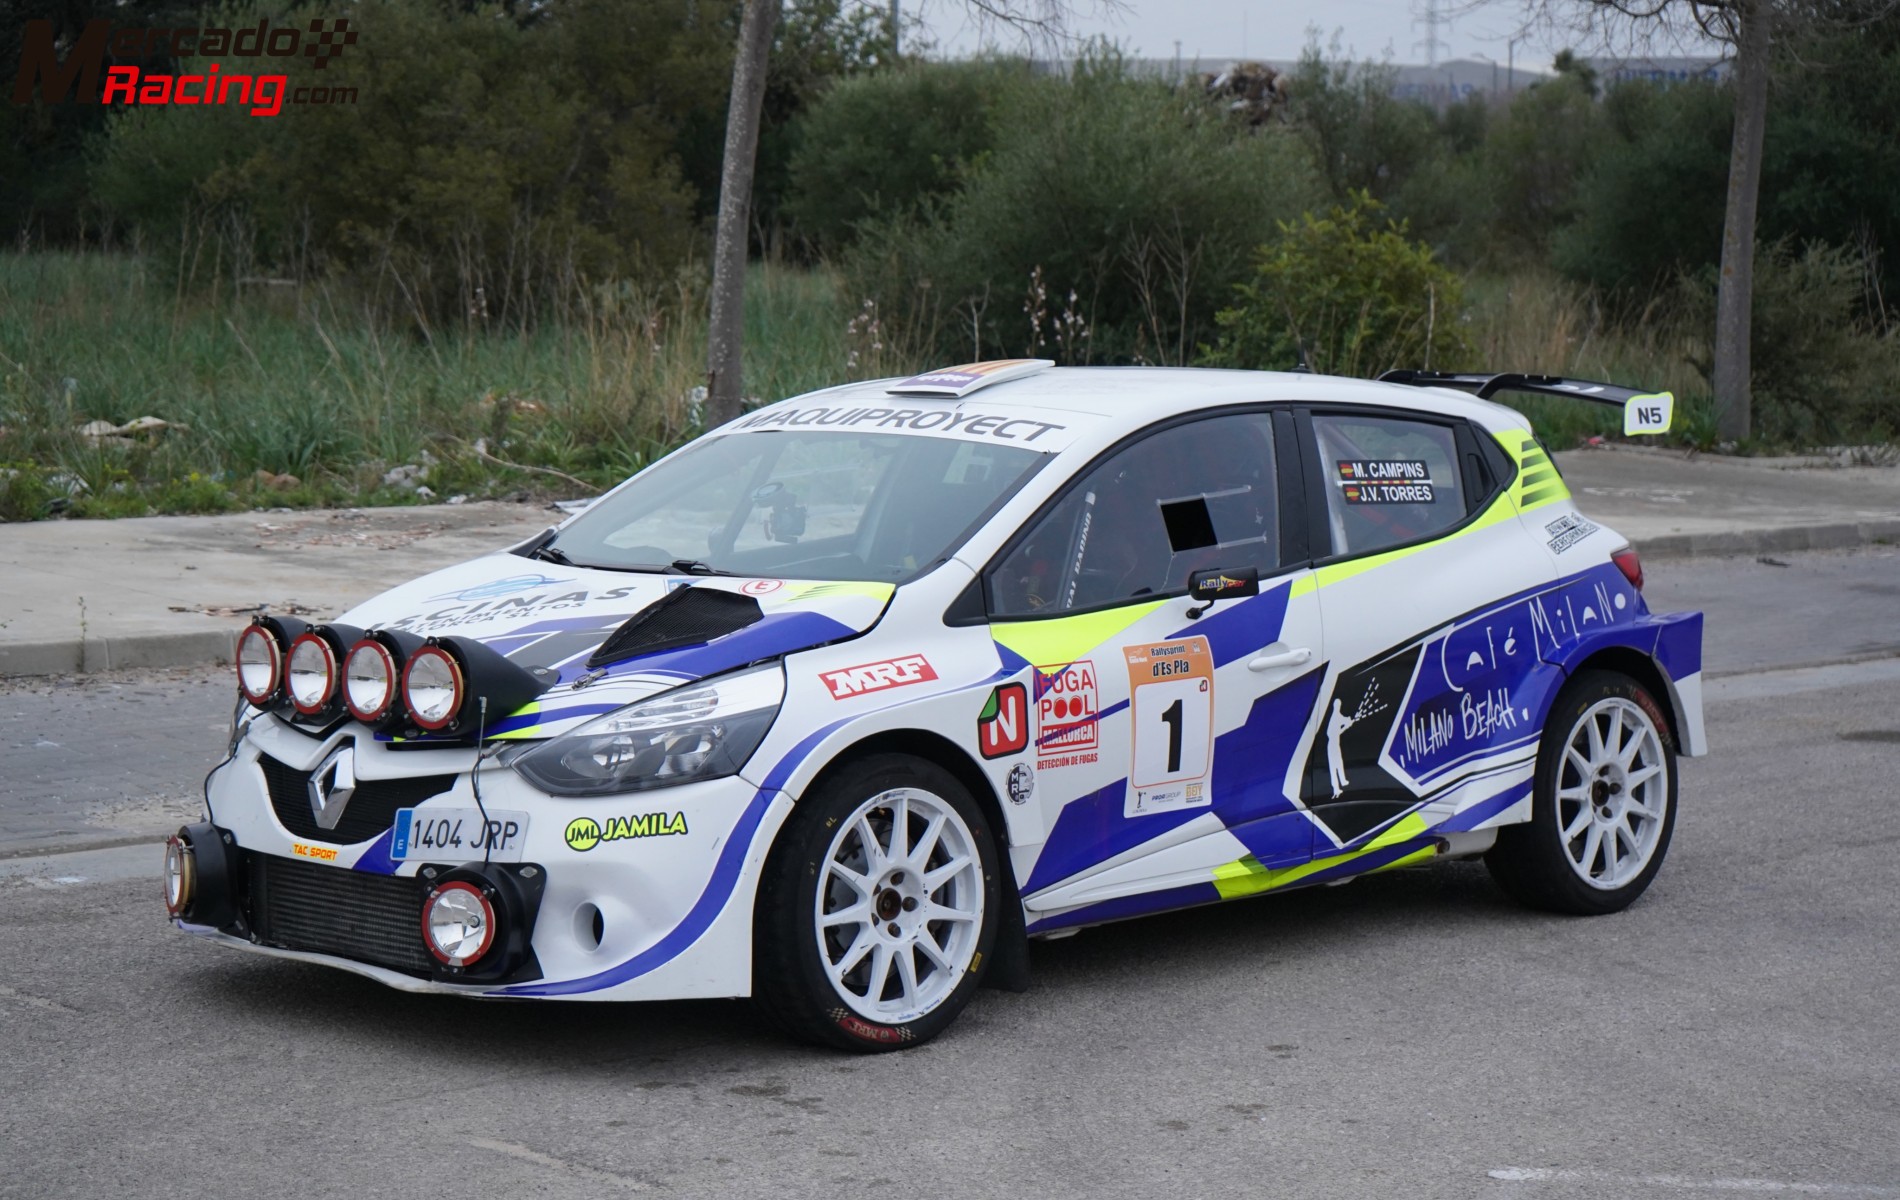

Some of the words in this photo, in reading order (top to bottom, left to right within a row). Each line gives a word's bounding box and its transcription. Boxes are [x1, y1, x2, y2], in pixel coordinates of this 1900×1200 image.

[731, 408, 1066, 441] MAQUIPROYECT
[1637, 407, 1662, 424] N5
[1352, 463, 1368, 477] M.
[1369, 463, 1424, 477] CAMPINS
[1381, 486, 1432, 501] TORRES
[371, 587, 637, 630] ISCINAS
[1151, 645, 1186, 656] Rallysprint
[826, 656, 925, 697] MRF
[1174, 660, 1189, 674] Pla
[1040, 669, 1093, 694] FUGA
[1041, 694, 1095, 721] POOL
[1043, 724, 1094, 746] MALLORCA
[1162, 699, 1183, 773] 1
[1071, 755, 1078, 766] DE
[1079, 753, 1098, 765] FUGAS
[397, 839, 404, 849] E
[414, 819, 462, 848] 1404
[470, 820, 518, 850] JRP
[568, 825, 600, 842] JML
[601, 811, 688, 841] JAMILA
[293, 844, 308, 856] TAC
[310, 847, 338, 861] SPORT
